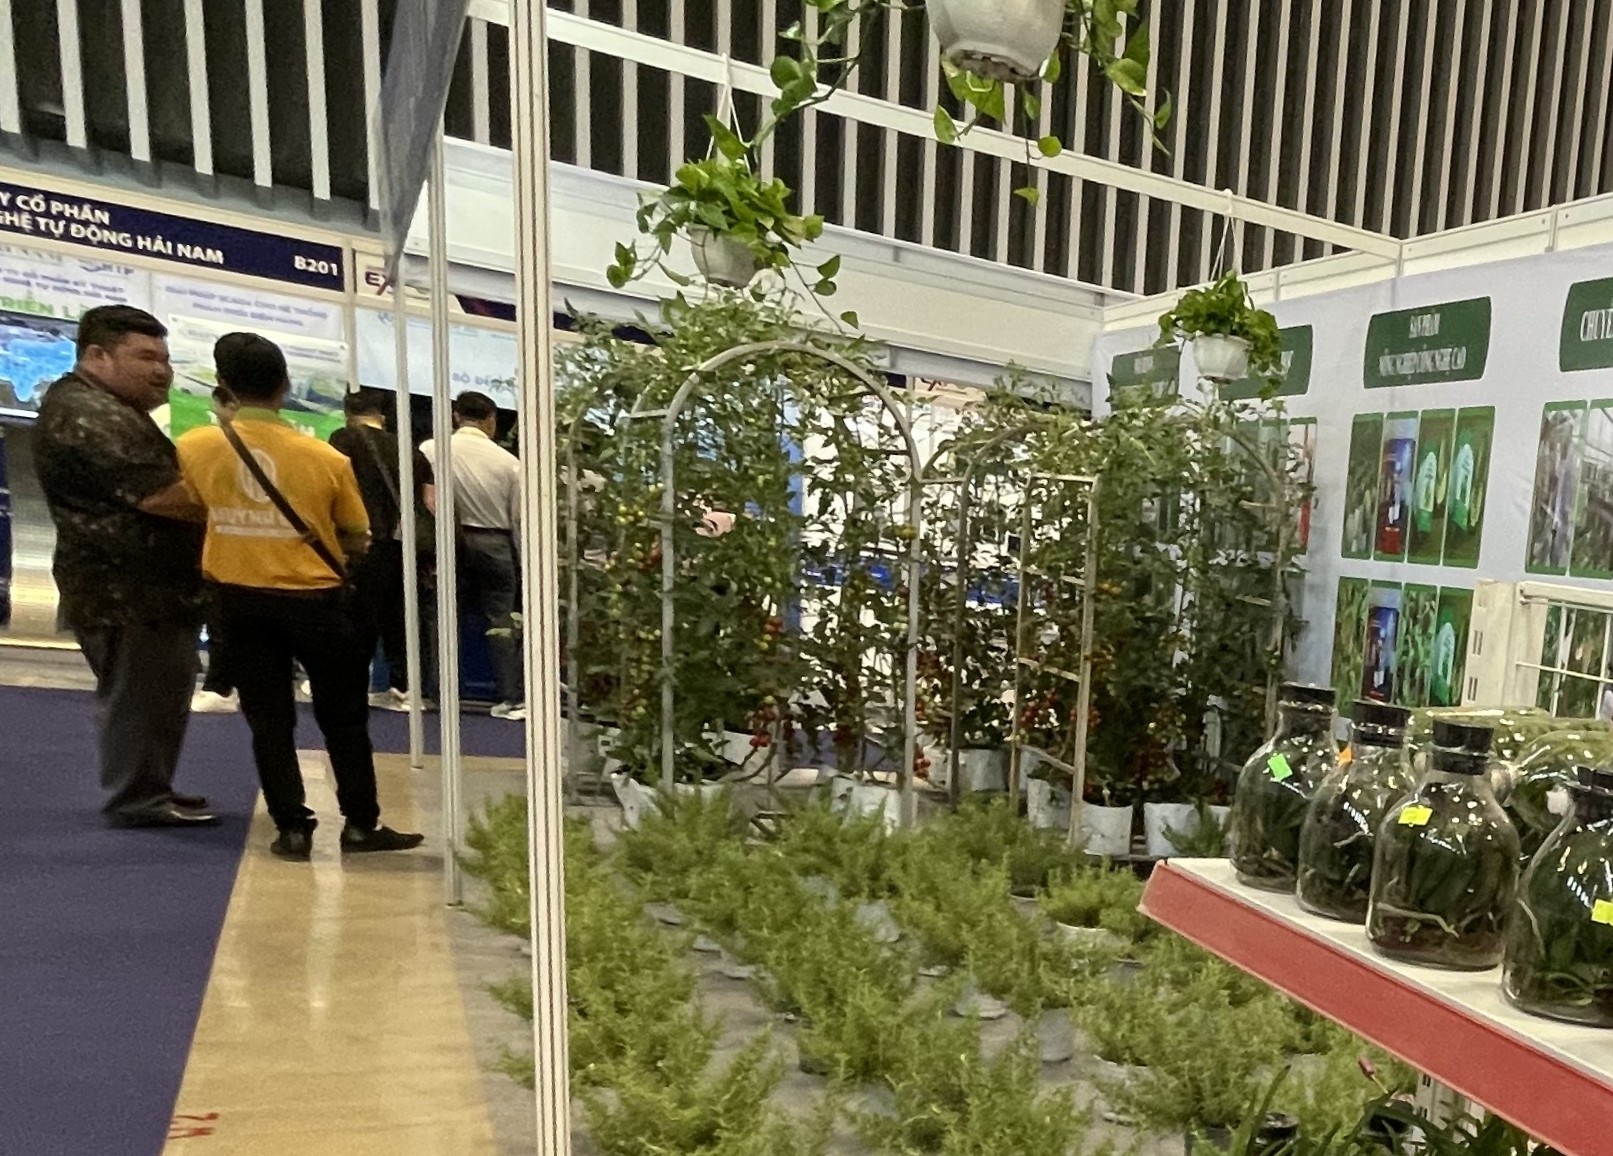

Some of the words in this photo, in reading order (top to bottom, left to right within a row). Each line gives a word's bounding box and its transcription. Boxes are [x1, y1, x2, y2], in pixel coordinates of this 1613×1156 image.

[16, 193, 46, 213] CỔ
[70, 222, 134, 248] ĐỘNG
[137, 233, 173, 256] HẢI
[176, 242, 225, 265] NAM
[293, 255, 339, 276] B201
